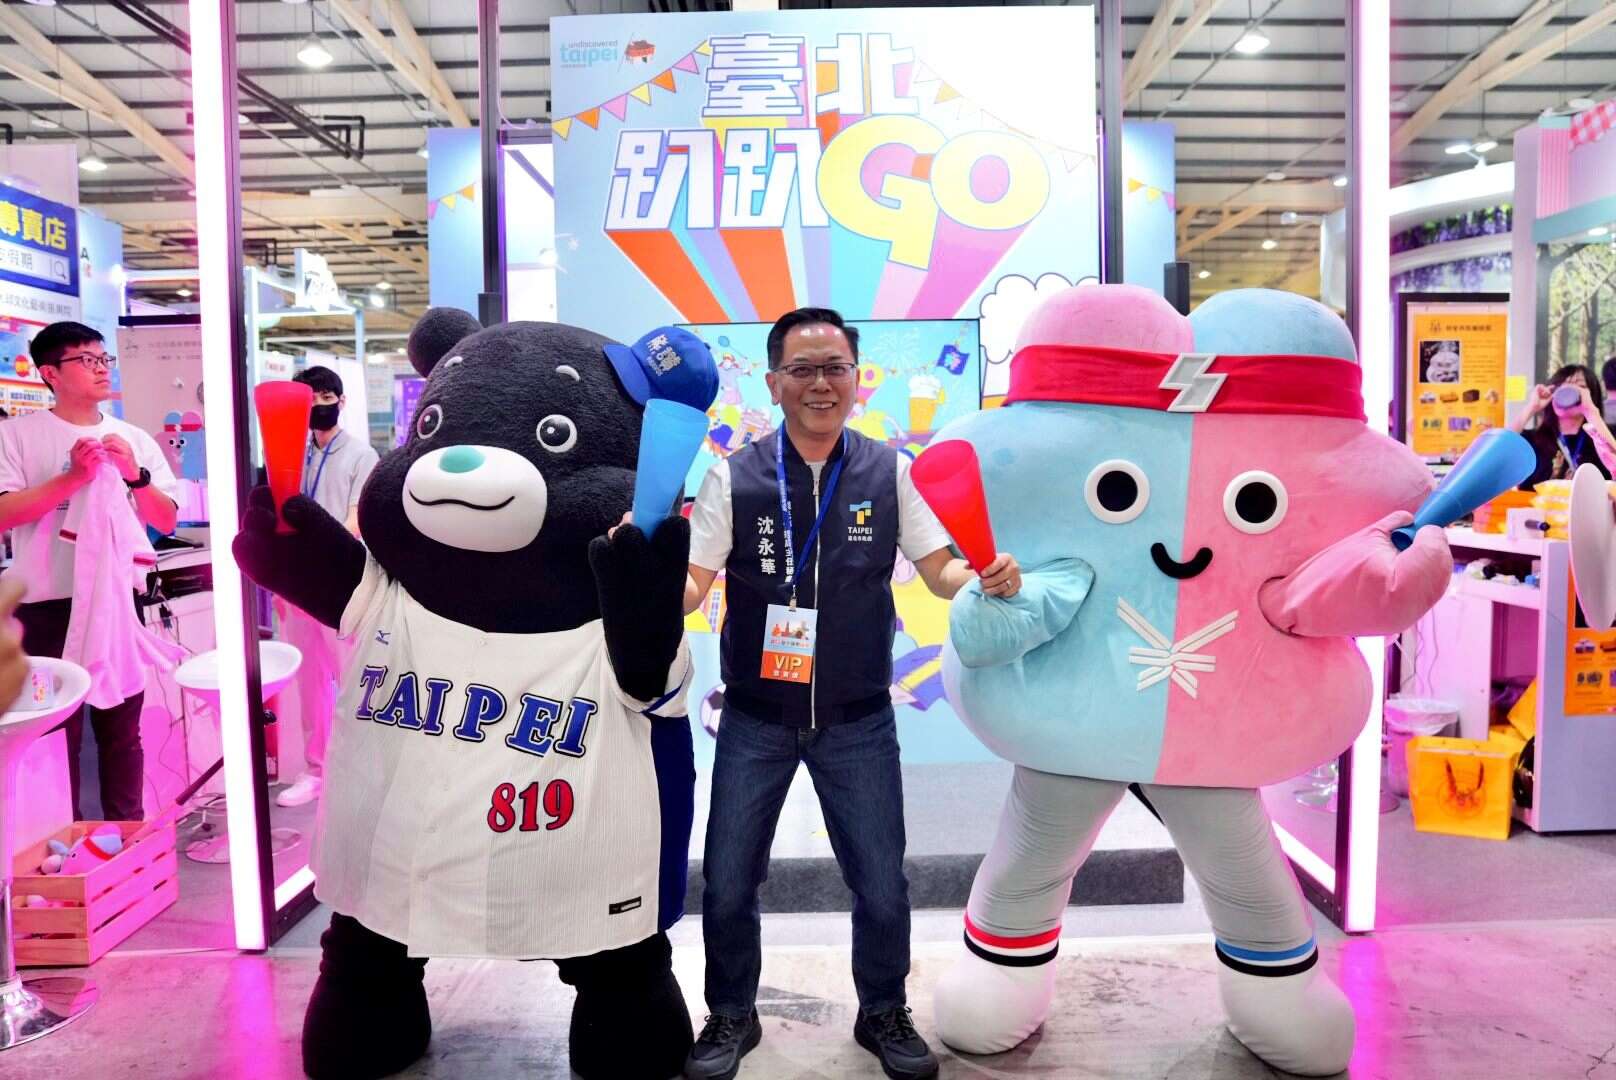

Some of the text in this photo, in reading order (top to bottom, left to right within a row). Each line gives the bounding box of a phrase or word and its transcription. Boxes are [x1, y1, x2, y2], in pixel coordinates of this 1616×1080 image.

[560, 43, 618, 64] taipei
[568, 40, 618, 48] undiscovered
[701, 33, 920, 117] 臺北
[757, 516, 777, 575] 沈永華
[847, 526, 873, 535] TAIPEI
[775, 654, 802, 671] VIP
[356, 665, 598, 758] TAIPEI
[486, 779, 575, 833] 819
